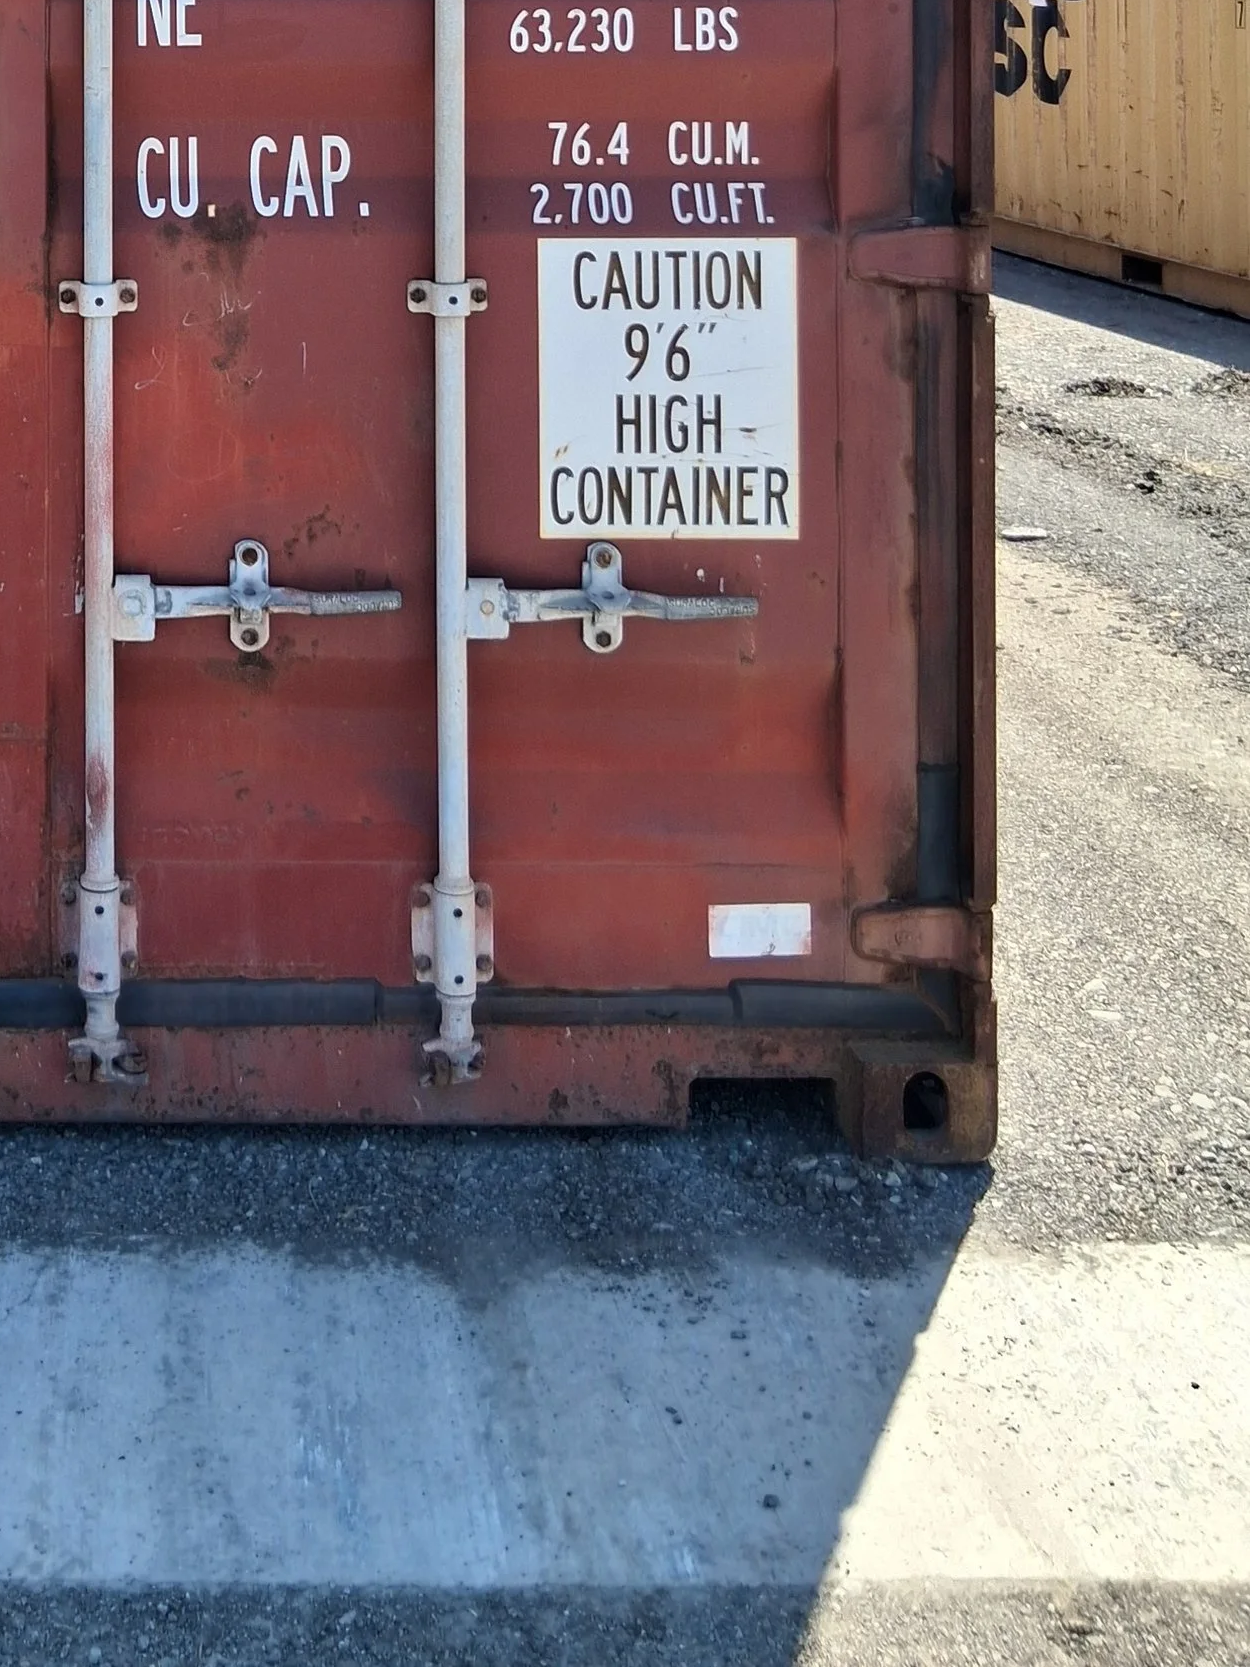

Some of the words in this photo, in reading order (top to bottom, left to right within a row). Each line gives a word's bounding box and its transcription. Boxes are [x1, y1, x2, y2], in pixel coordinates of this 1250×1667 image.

[675, 7, 738, 51] LBS
[250, 136, 369, 216] CAP.
[549, 122, 629, 165] 76.4
[669, 122, 759, 165] CU.M.
[672, 183, 774, 223] CU.FT.
[574, 251, 761, 309] CAUTION
[617, 395, 721, 453] HIGH
[551, 465, 789, 526] CONTAINER
